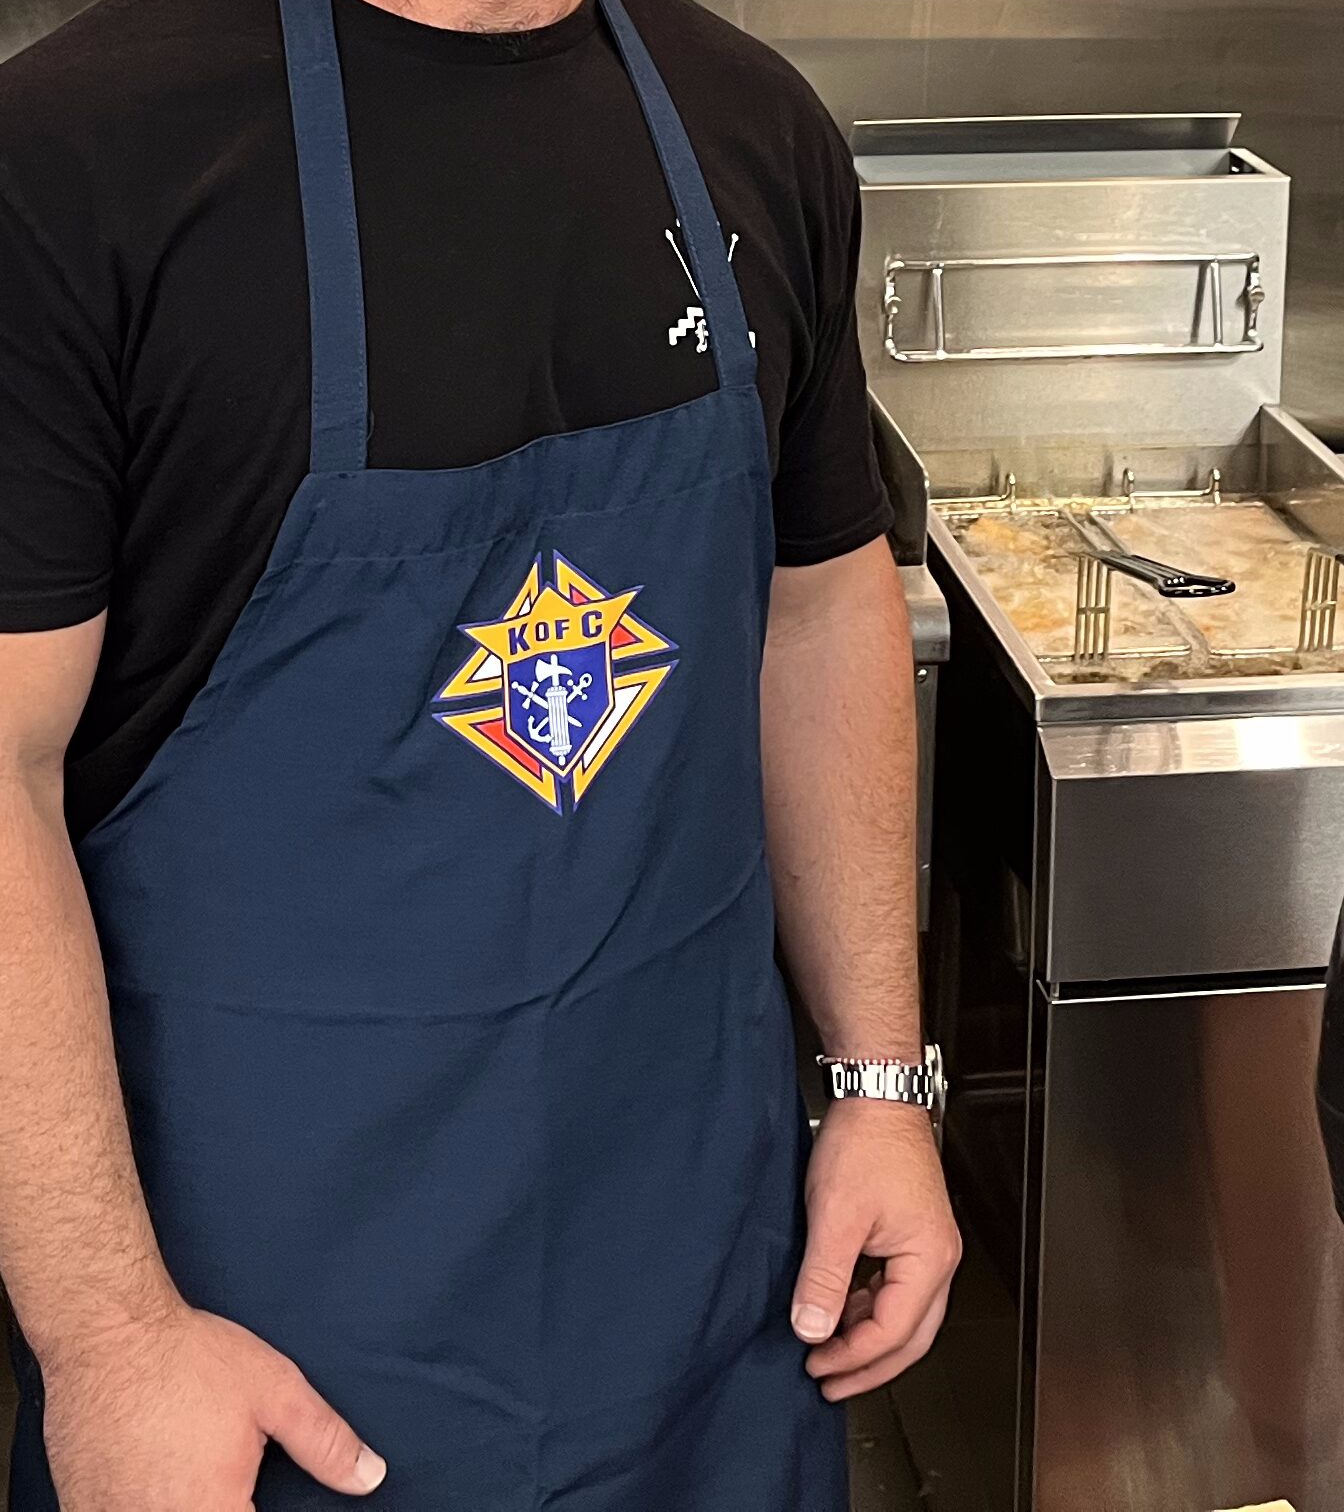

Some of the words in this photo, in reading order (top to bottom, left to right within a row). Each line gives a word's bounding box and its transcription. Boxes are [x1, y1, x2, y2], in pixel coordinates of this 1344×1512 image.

[508, 623, 530, 655] K
[535, 619, 570, 642] OF
[581, 610, 602, 638] C
